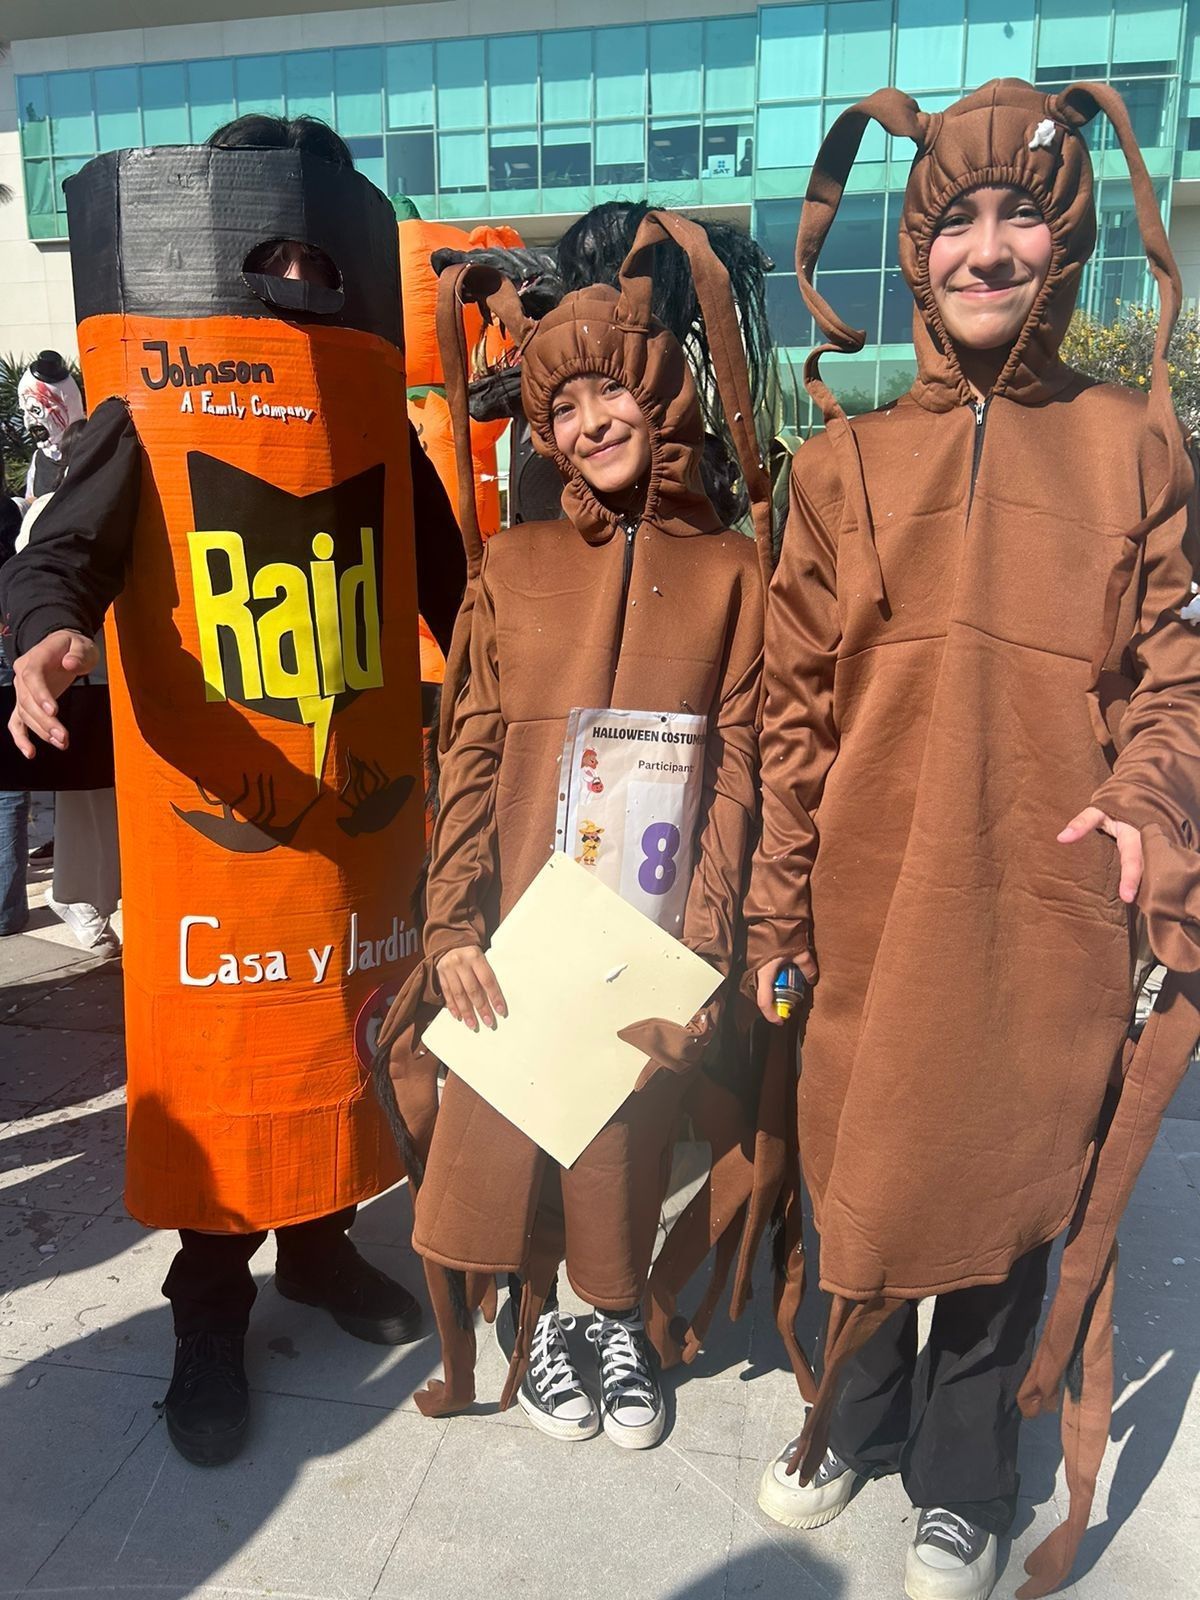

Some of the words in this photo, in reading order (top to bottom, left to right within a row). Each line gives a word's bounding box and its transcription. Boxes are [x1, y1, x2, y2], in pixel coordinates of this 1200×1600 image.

[141, 341, 274, 389] Johnson
[180, 391, 194, 414] A
[201, 391, 246, 419] Family
[251, 395, 318, 422] Company
[186, 527, 384, 702] Raid
[592, 726, 659, 743] HALLOWEEN
[638, 760, 694, 774] Participant
[638, 822, 681, 895] 8
[180, 915, 290, 987] Casa
[307, 945, 334, 983] y
